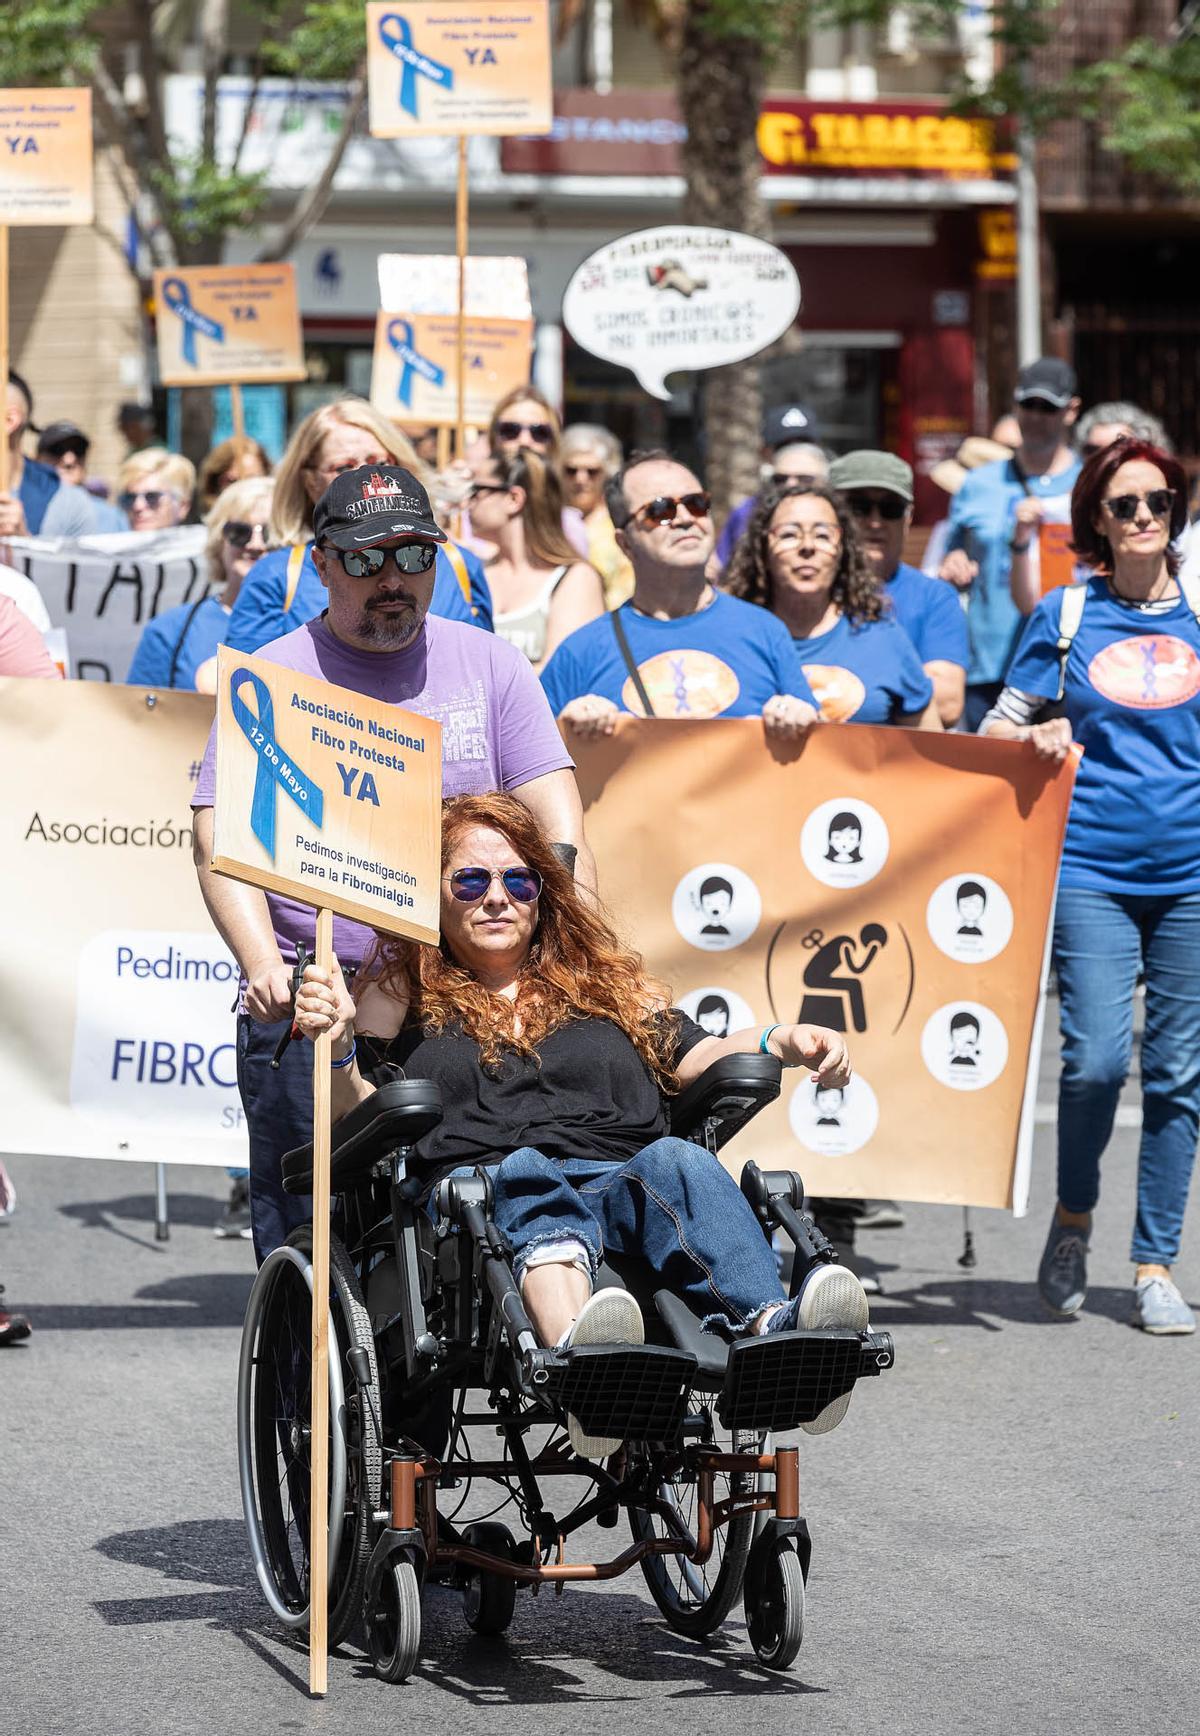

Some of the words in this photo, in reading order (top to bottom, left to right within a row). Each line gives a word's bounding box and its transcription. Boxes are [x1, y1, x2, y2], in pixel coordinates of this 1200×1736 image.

[465, 48, 498, 65] YA
[6, 136, 39, 155] YA
[291, 692, 365, 732] Asociación
[368, 719, 425, 753] Nacional
[250, 727, 265, 745] 12
[263, 744, 278, 766] De
[279, 764, 308, 801] Mayo
[311, 726, 345, 751] Fibro
[350, 740, 405, 772] Protesta
[336, 761, 381, 807] YA
[25, 811, 193, 849] Asociación
[296, 835, 343, 862] Pedimos
[346, 852, 417, 887] investigación
[300, 861, 325, 878] para
[328, 867, 339, 882] la
[342, 872, 414, 907] Fibromialgia
